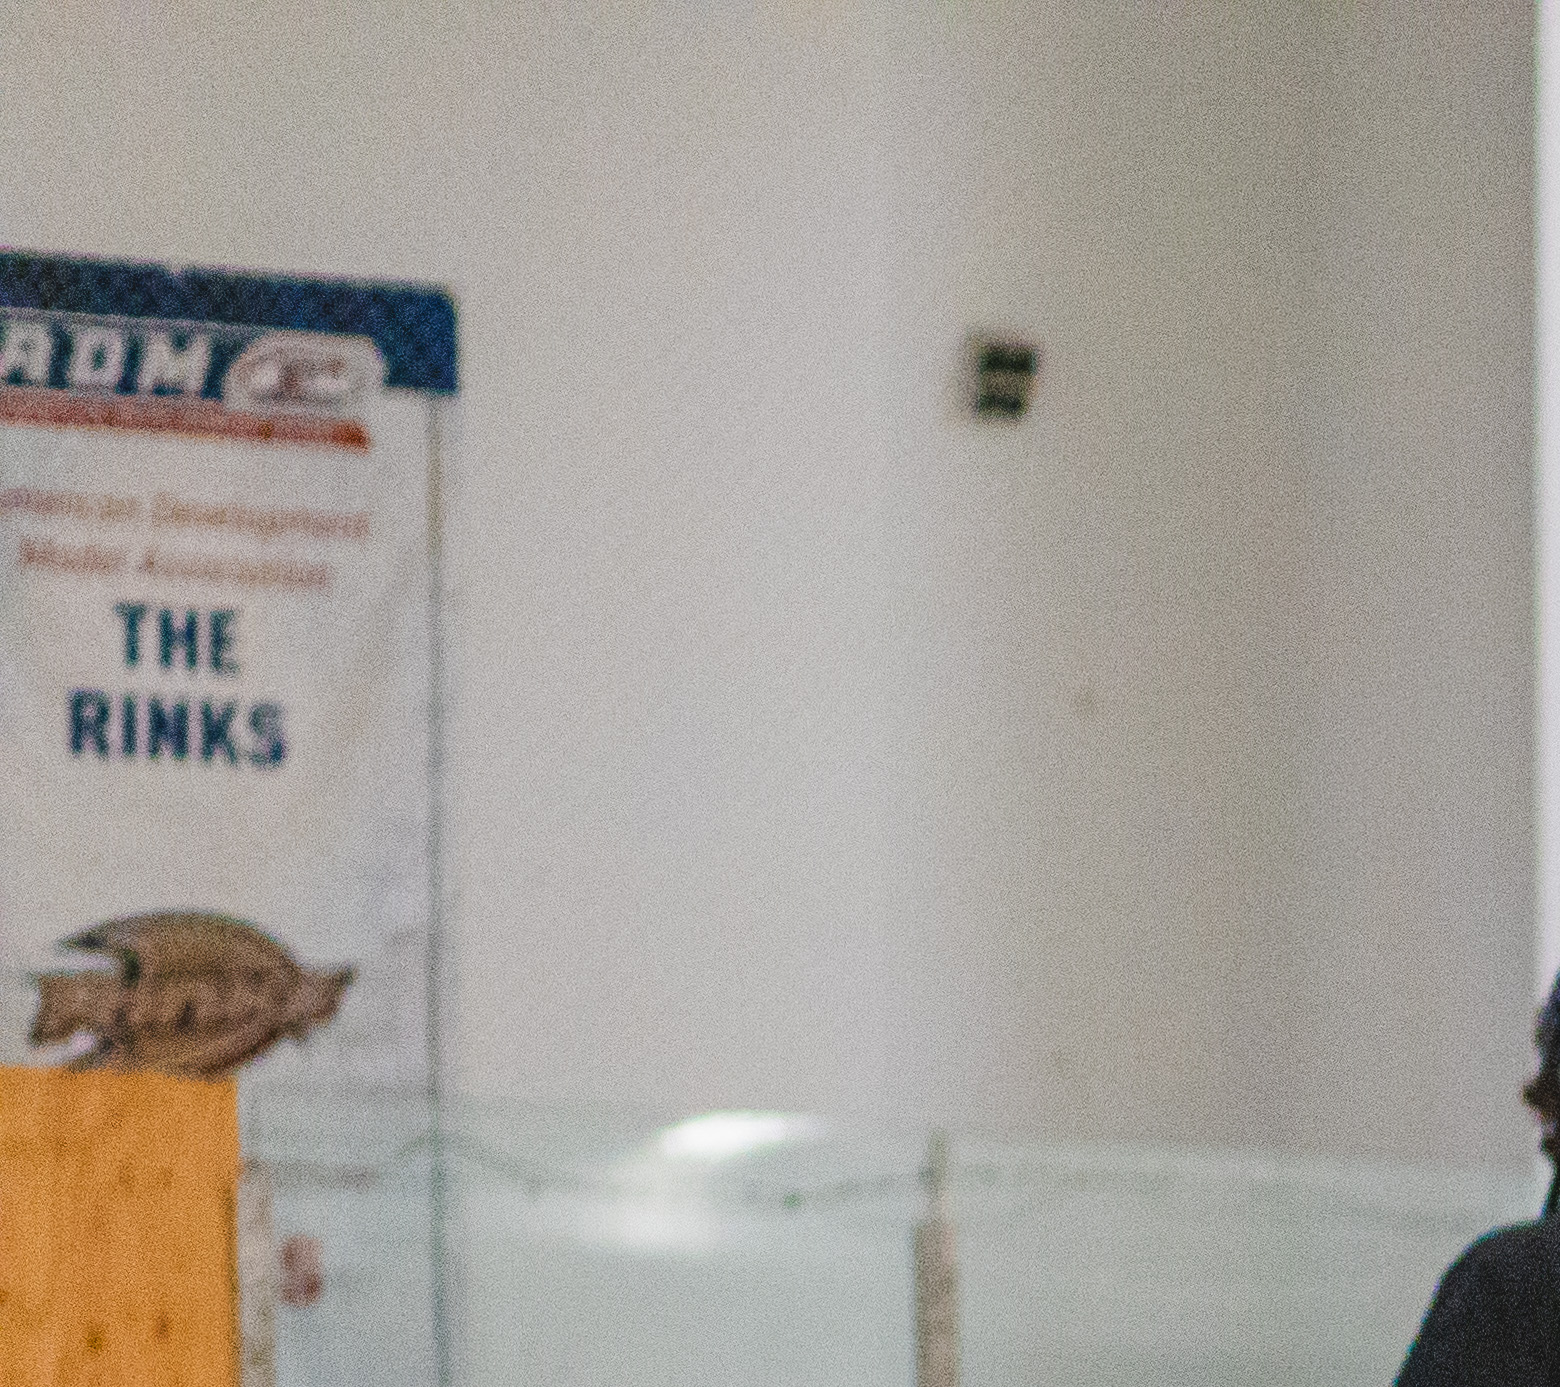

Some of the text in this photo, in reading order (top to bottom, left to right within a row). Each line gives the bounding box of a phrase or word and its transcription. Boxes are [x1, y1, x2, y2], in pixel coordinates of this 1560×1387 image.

[0, 484, 142, 526] merican
[114, 600, 242, 675] THE
[67, 689, 287, 769] RINKS
